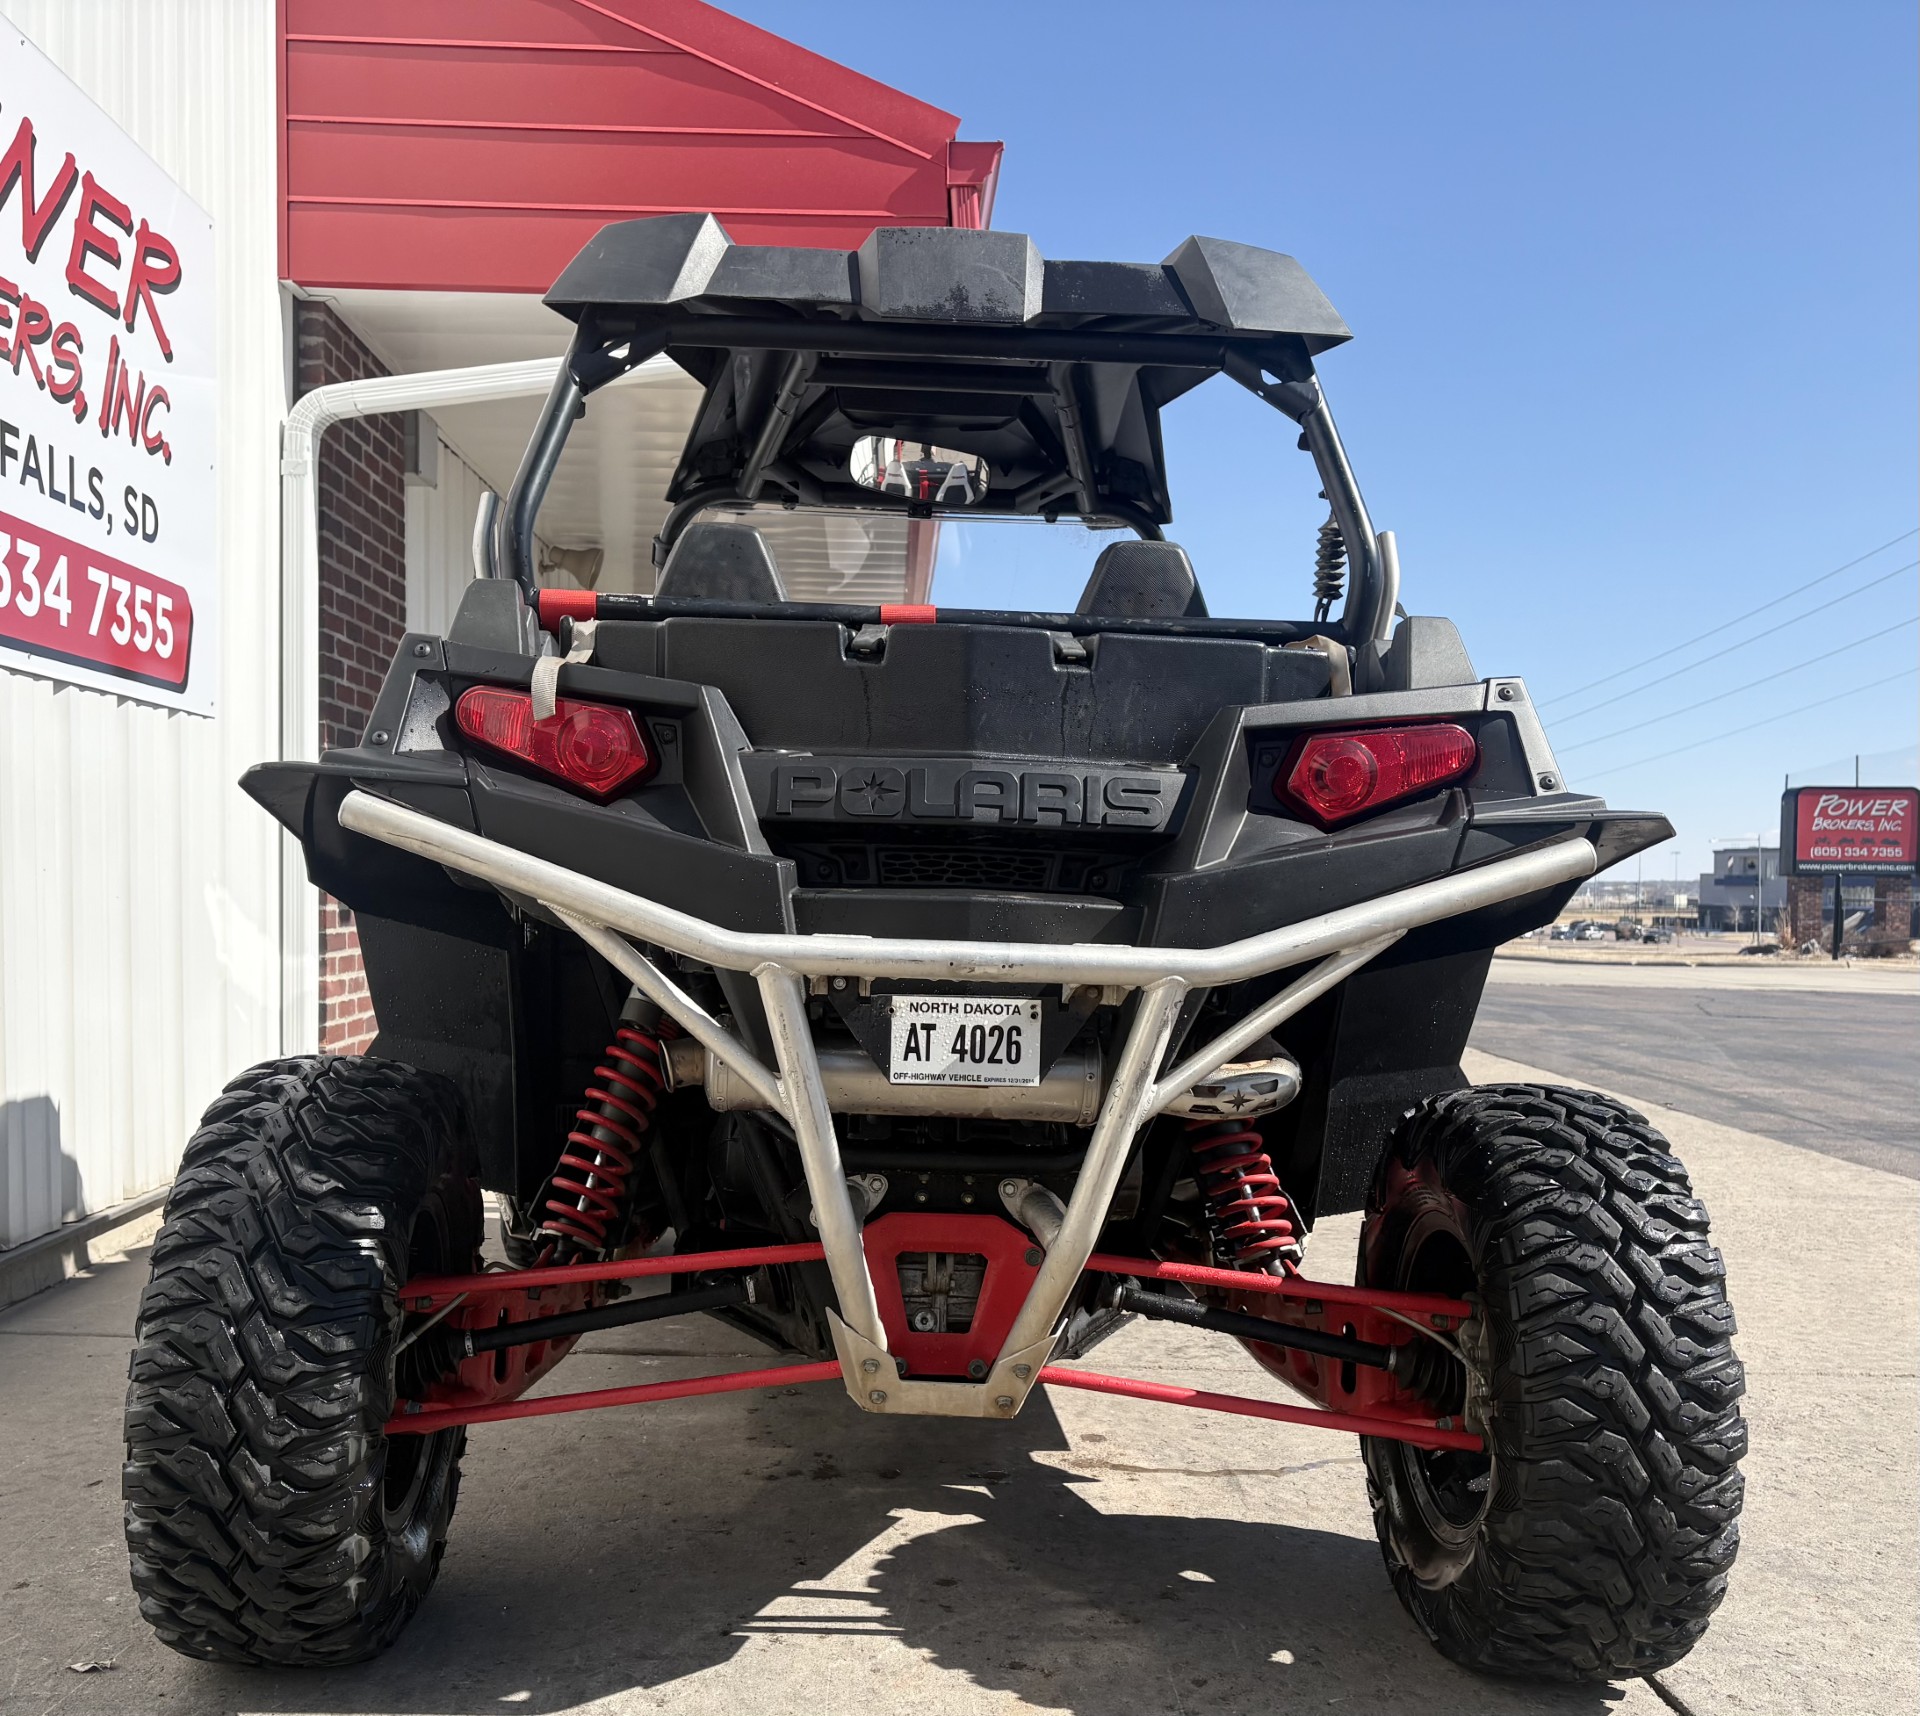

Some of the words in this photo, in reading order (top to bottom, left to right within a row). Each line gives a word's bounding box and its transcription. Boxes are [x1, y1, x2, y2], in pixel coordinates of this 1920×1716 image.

[99, 334, 171, 466] INC.
[0, 418, 112, 535] FALLS,
[124, 485, 158, 543] SD
[87, 565, 173, 659] 7355
[774, 765, 1165, 828] POLARIS
[1813, 794, 1909, 817] POWER
[1878, 817, 1902, 832] INC.
[1810, 846, 1842, 859] (605)
[1844, 847, 1868, 857] 334
[1871, 847, 1903, 857] 7355
[1798, 863, 1915, 872] www.powerbrokersinc.com
[909, 1002, 959, 1014] NORTH
[963, 1003, 1021, 1016] DAKOTA
[903, 1022, 937, 1062] AT
[951, 1024, 1022, 1065] 4026
[893, 1072, 946, 1081] OFF-HIGHWAY
[949, 1073, 982, 1083] VEHICLE
